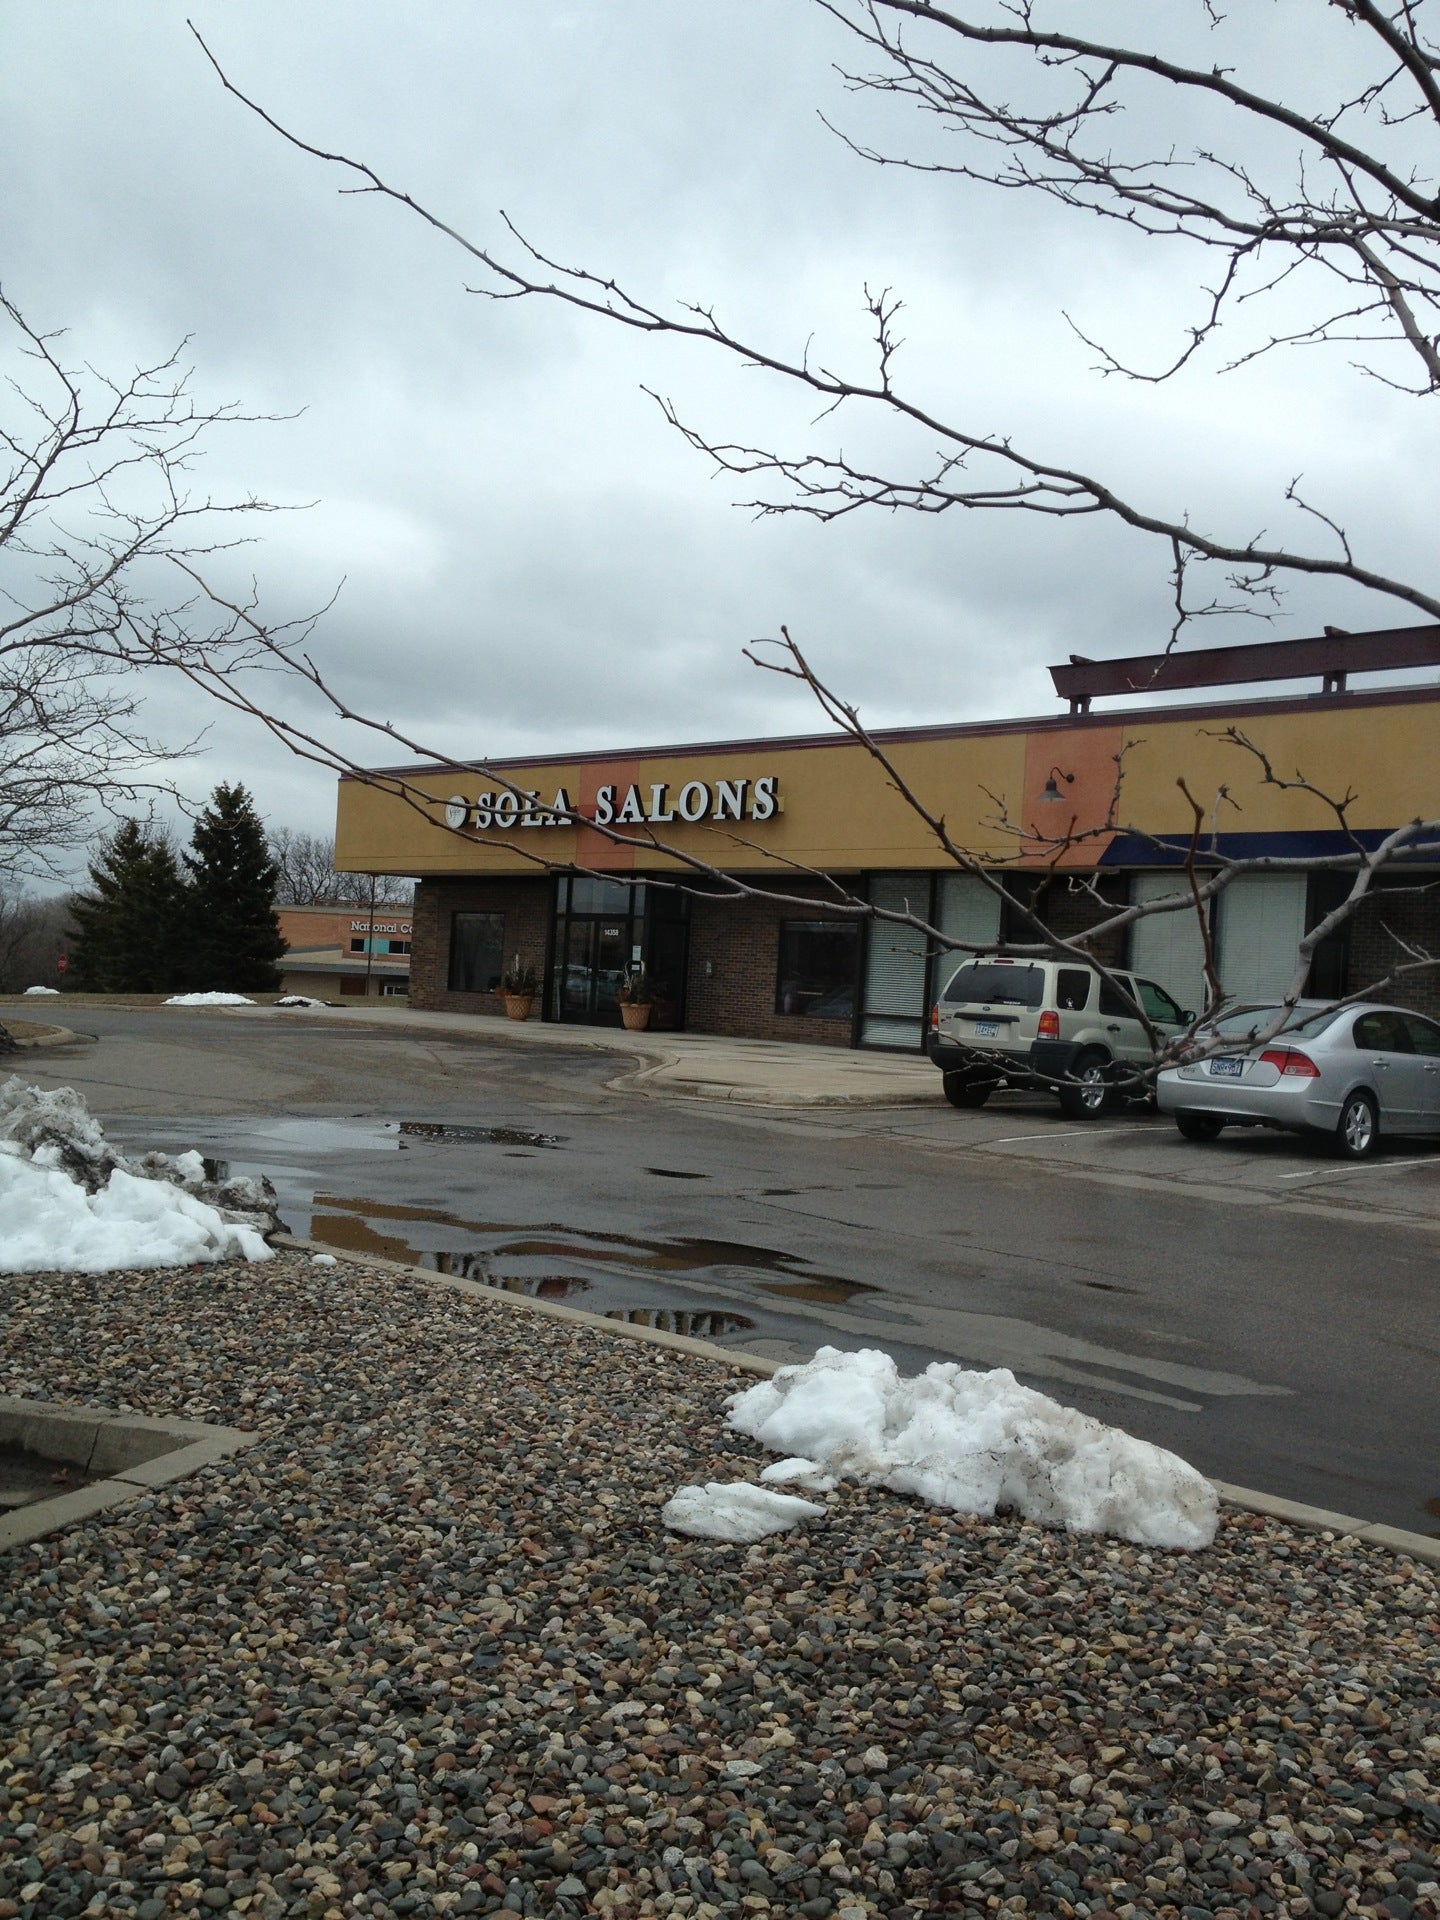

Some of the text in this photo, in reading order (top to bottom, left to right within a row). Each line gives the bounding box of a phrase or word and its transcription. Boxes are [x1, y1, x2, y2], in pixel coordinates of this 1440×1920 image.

[475, 776, 779, 830] SOLA SALONS
[351, 920, 397, 933] Natonal
